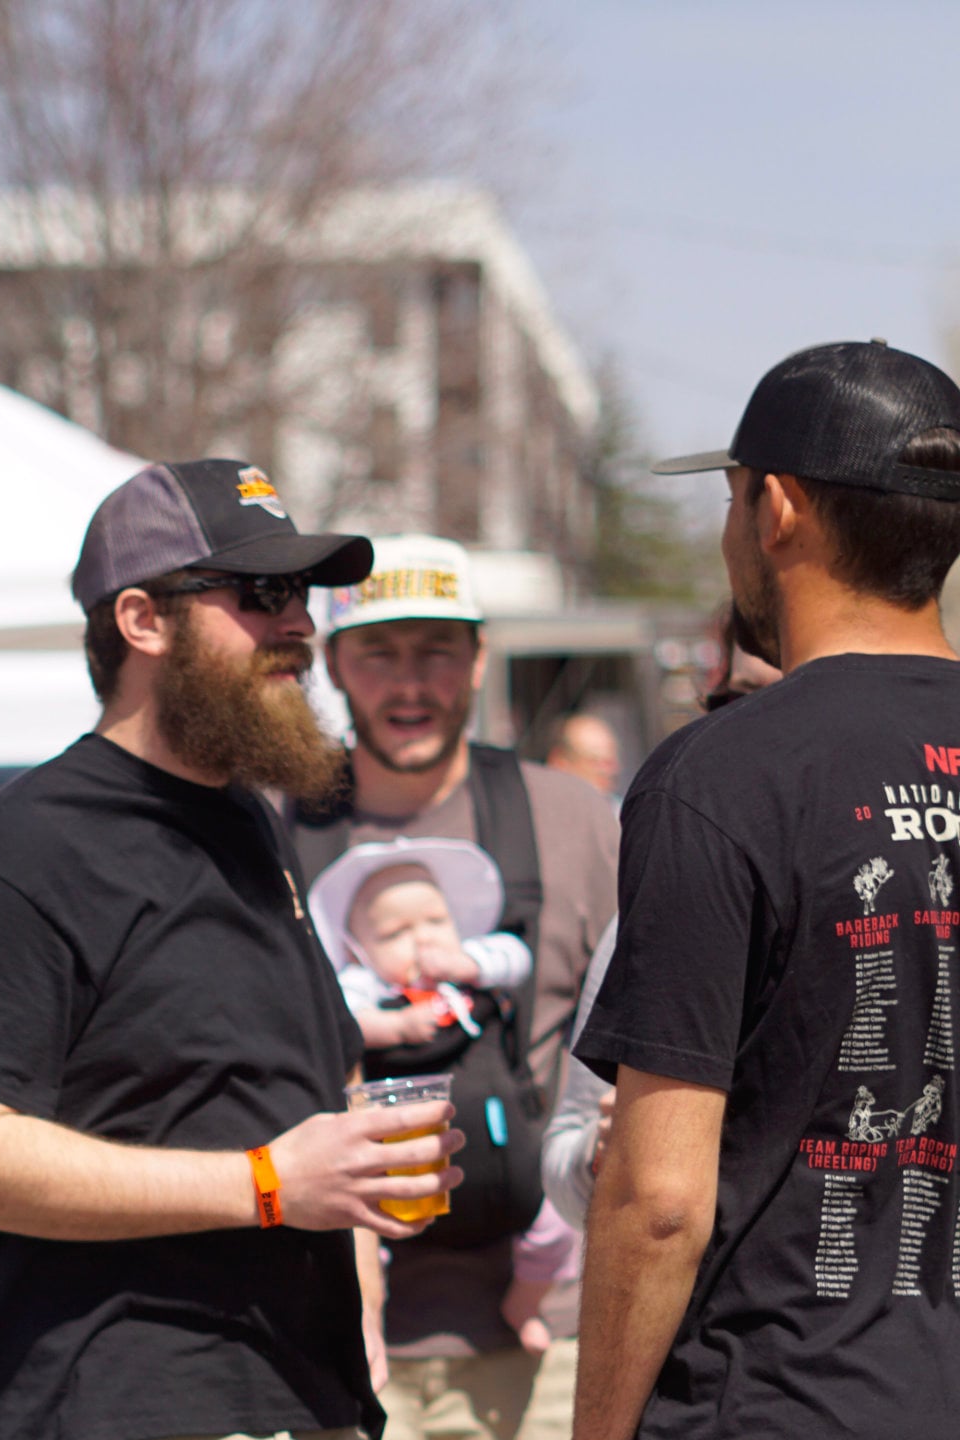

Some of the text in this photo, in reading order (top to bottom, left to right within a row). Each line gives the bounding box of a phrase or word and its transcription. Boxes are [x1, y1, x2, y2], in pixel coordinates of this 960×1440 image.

[854, 805, 872, 821] 20
[884, 807, 960, 846] RO
[835, 913, 899, 936] BAREBACK
[850, 929, 890, 948] RIDING
[800, 1139, 888, 1157] TEAM ROPING
[808, 1153, 877, 1172] (HEELING)
